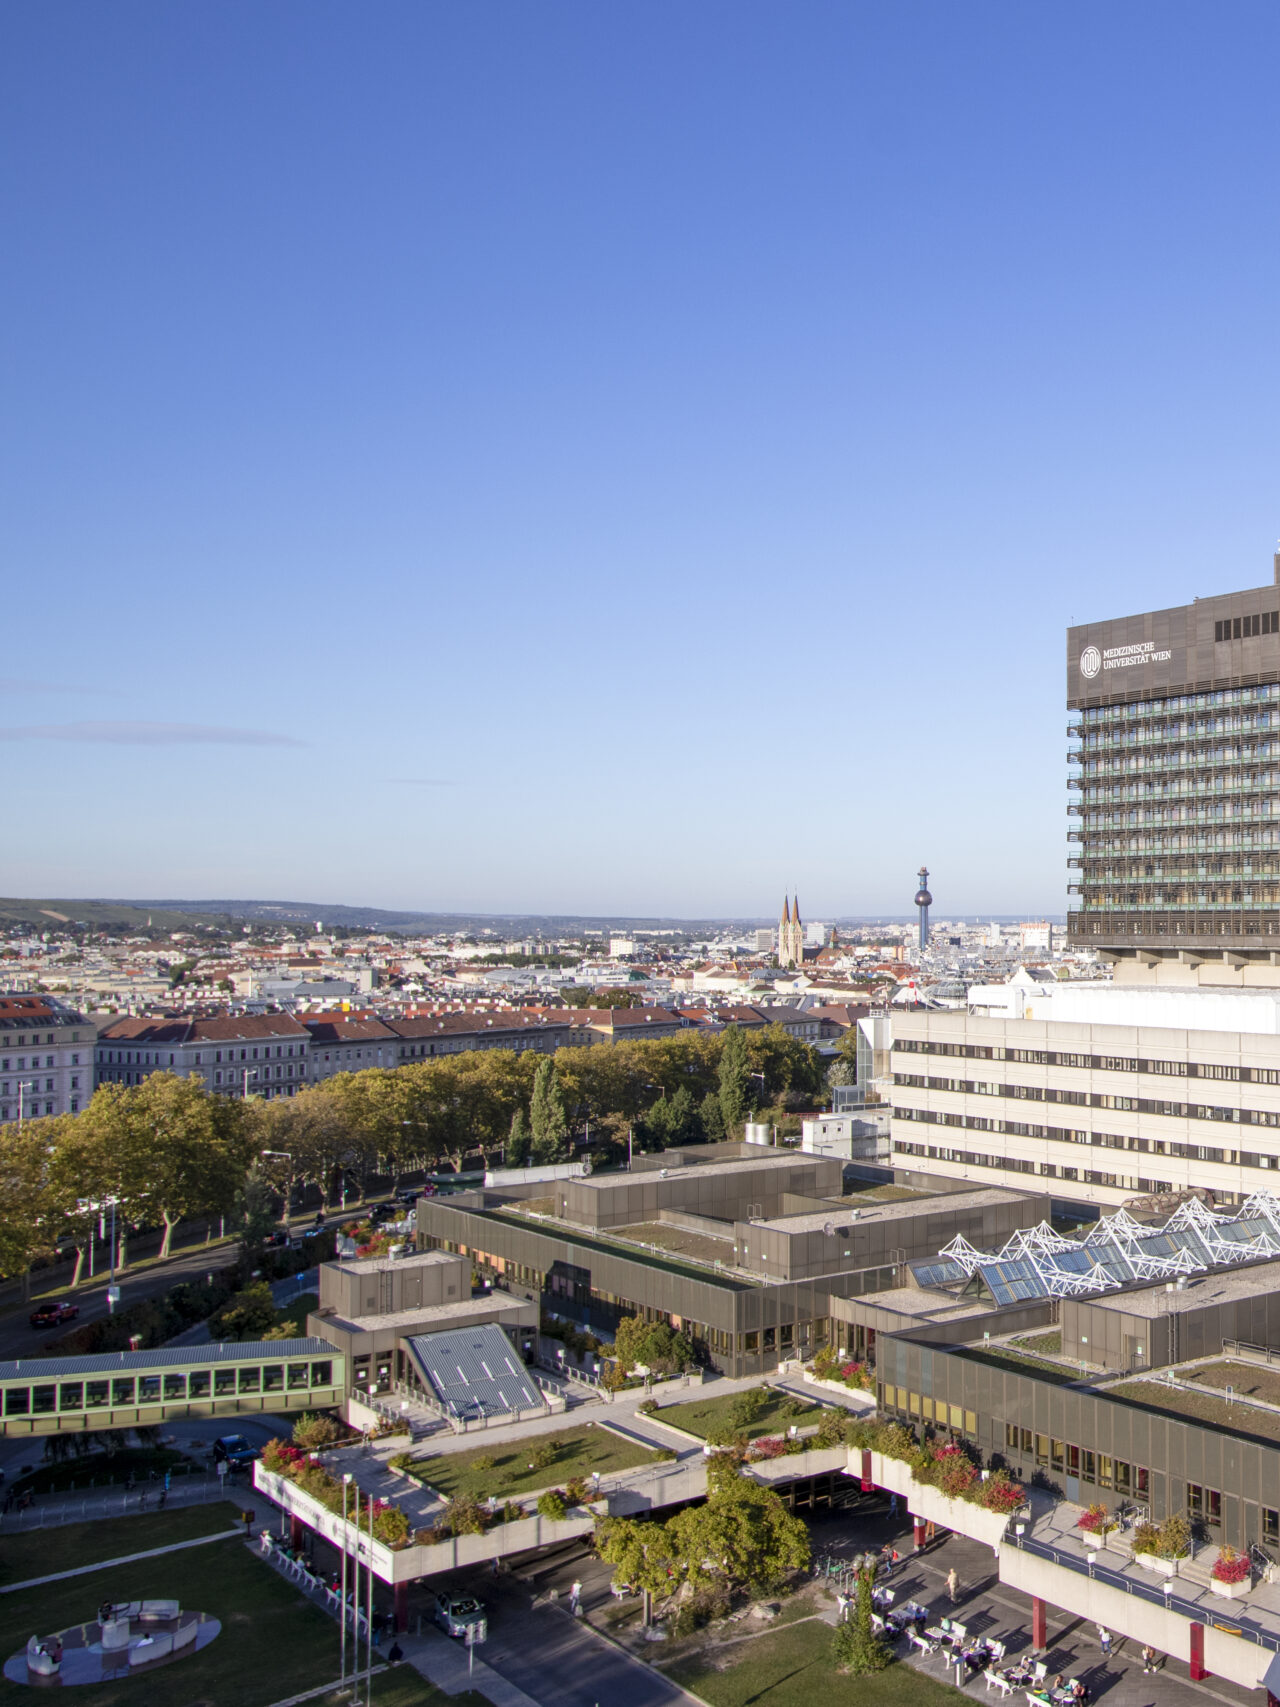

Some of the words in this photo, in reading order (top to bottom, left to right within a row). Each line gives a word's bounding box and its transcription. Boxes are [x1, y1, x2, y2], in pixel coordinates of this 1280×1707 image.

[1103, 642, 1155, 659] MEDIZINISCHE
[1103, 652, 1150, 670] UNIVERSITÄT
[1151, 650, 1172, 662] WIEN
